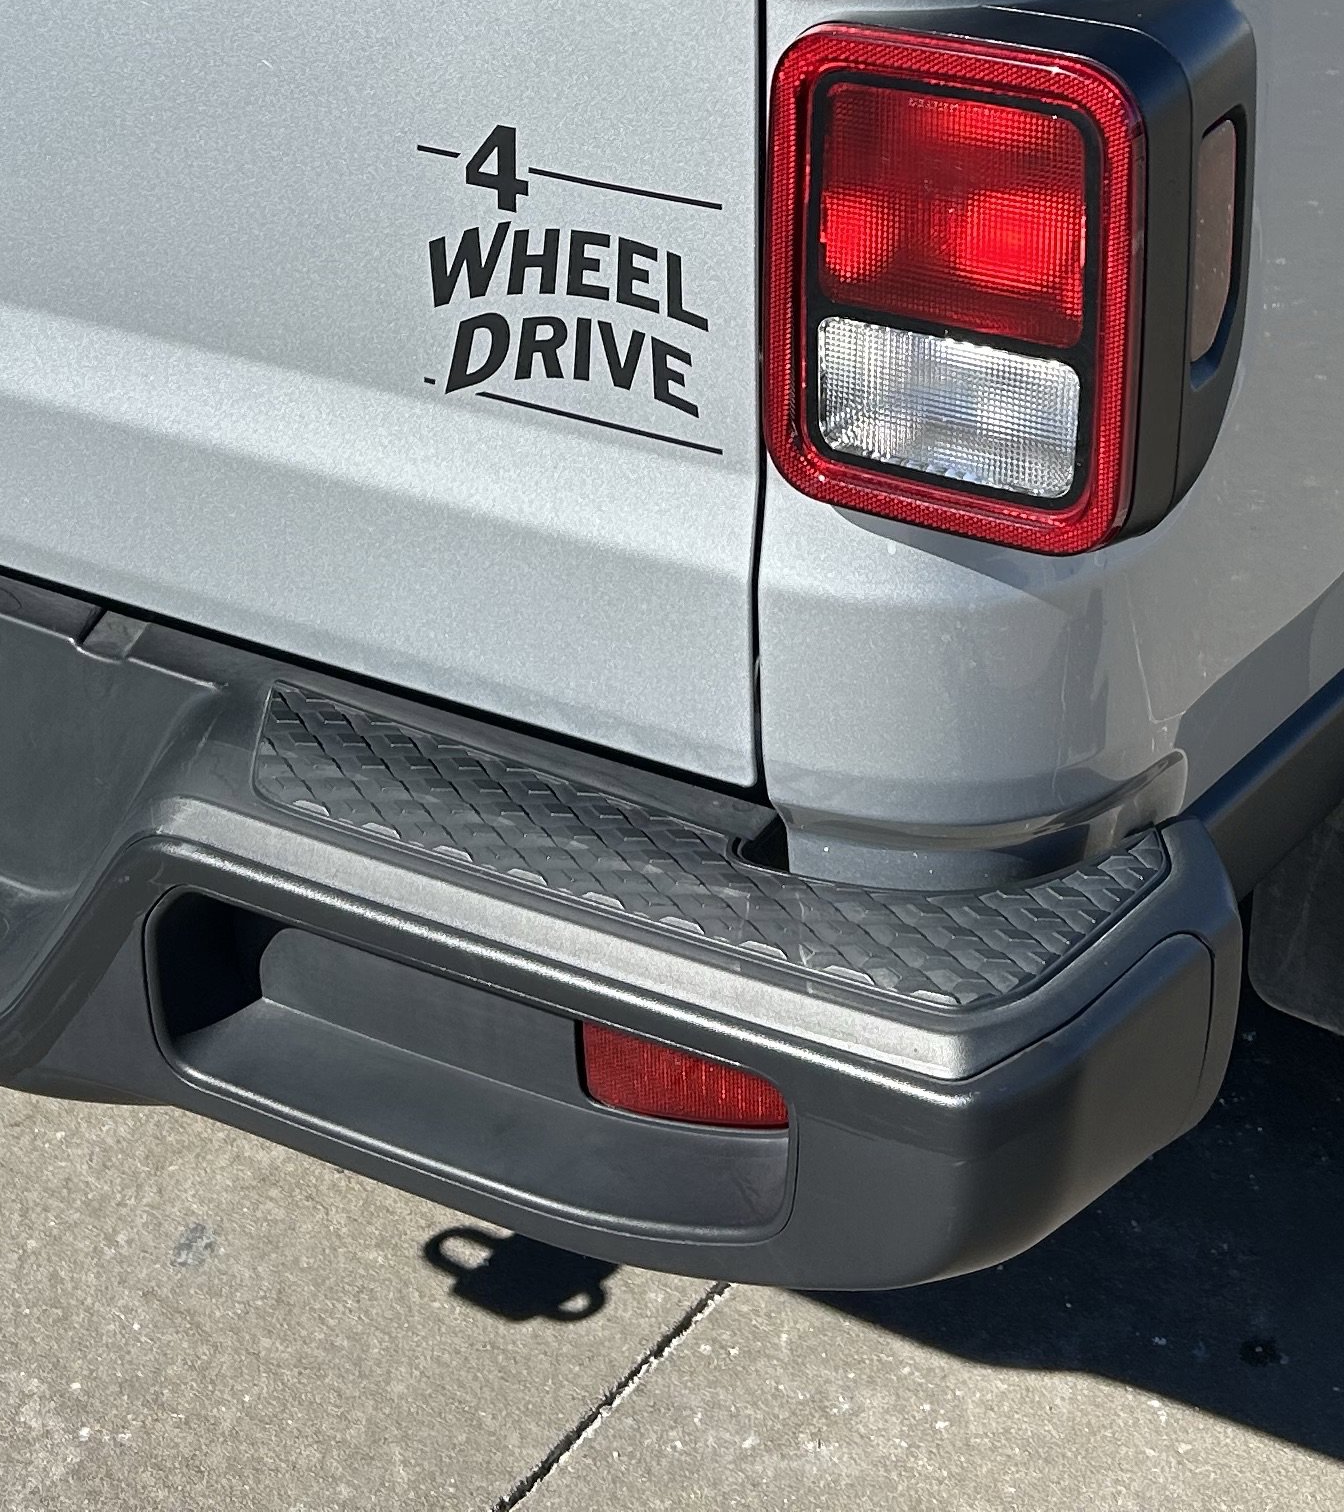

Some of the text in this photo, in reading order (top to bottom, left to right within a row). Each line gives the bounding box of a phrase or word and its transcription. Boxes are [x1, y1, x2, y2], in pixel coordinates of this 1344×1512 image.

[465, 124, 529, 213] 4
[428, 220, 709, 333] WHEEL
[444, 311, 700, 419] DRIVE
